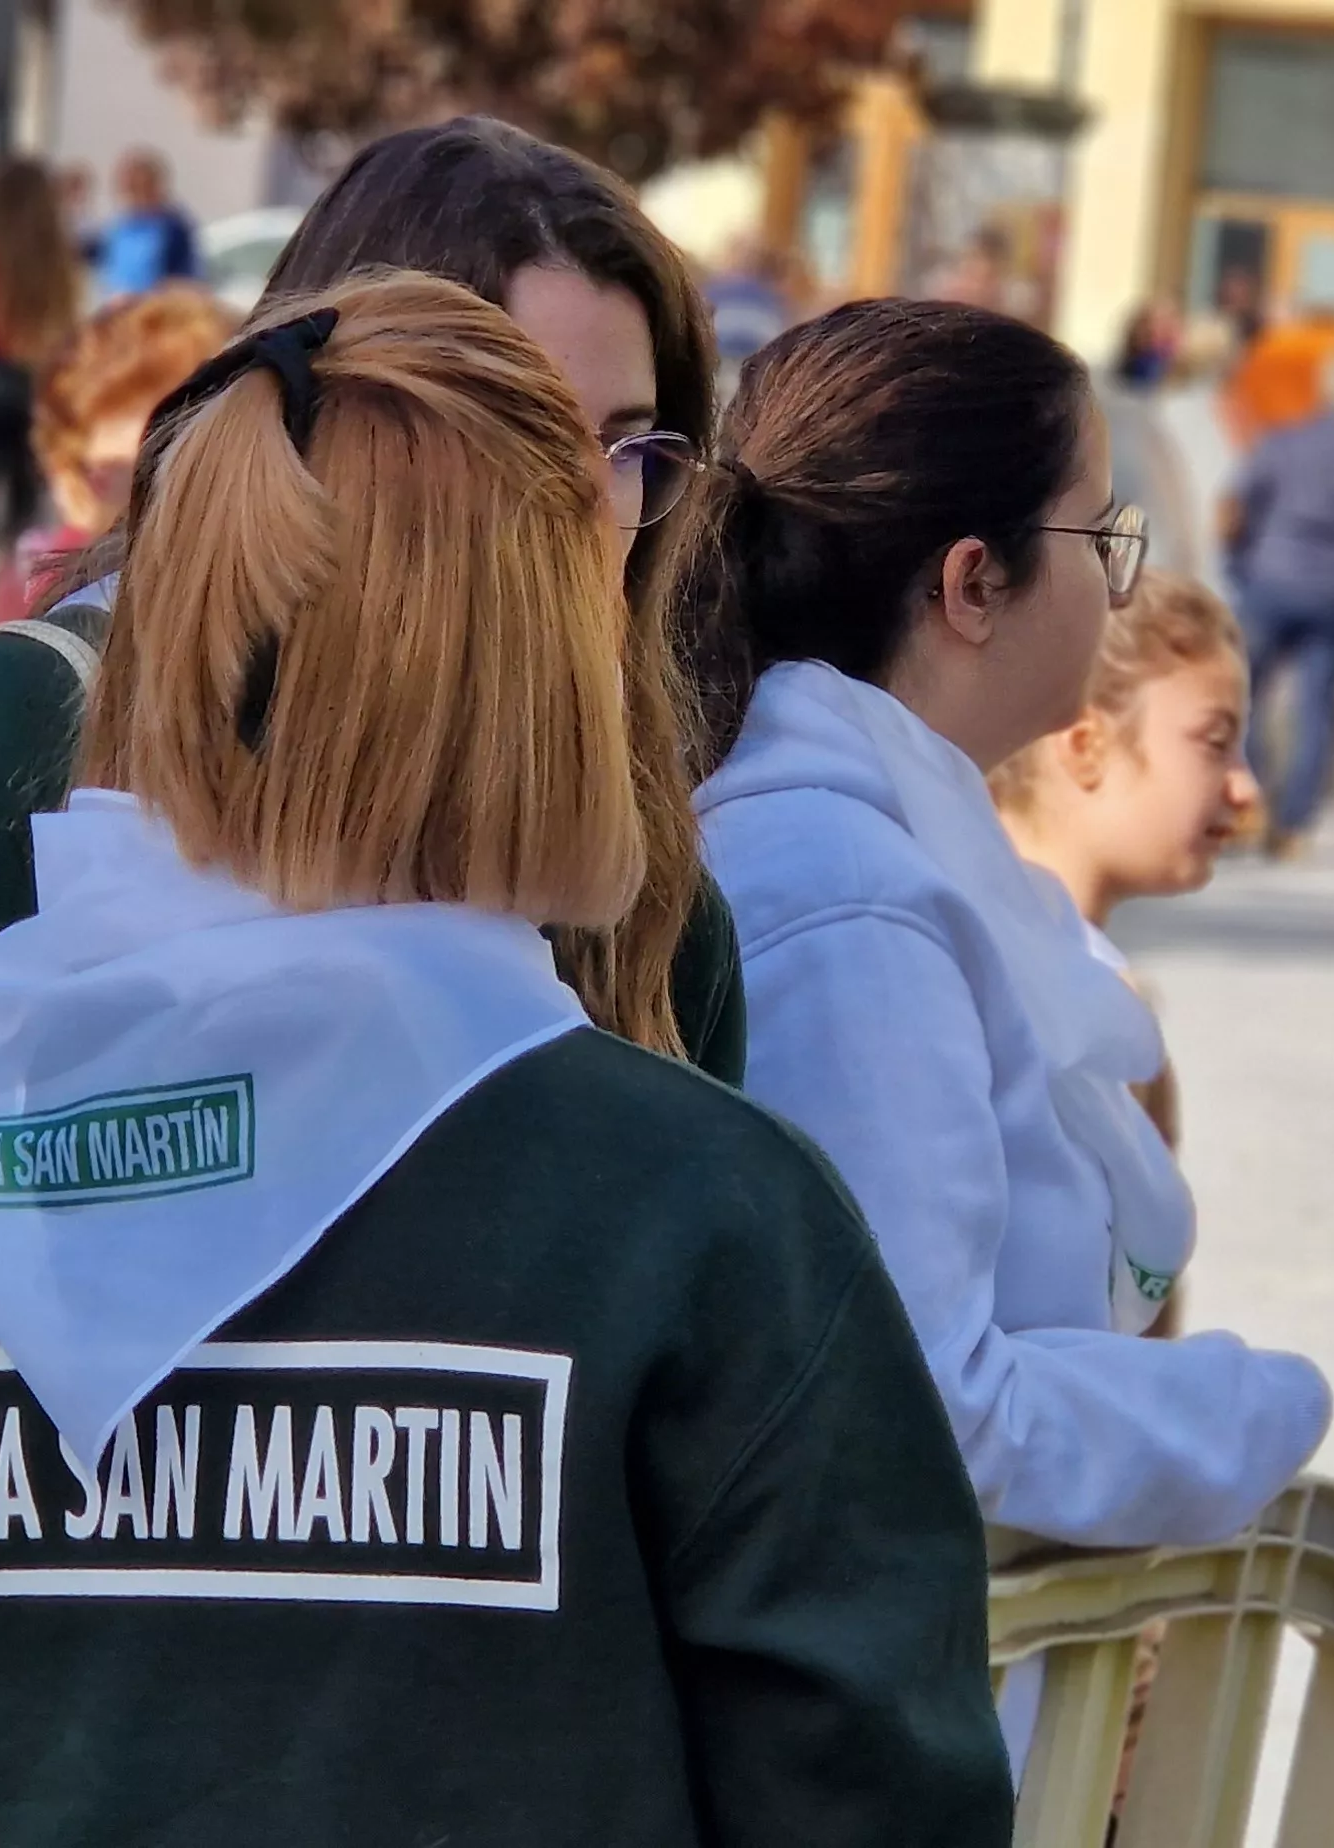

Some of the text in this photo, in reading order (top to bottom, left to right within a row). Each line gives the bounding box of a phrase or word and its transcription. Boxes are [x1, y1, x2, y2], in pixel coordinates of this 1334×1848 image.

[13, 1123, 80, 1187] SAN
[87, 1098, 229, 1180] MARTÍN
[59, 1404, 201, 1540] SAN
[224, 1404, 522, 1550] MARTIN
